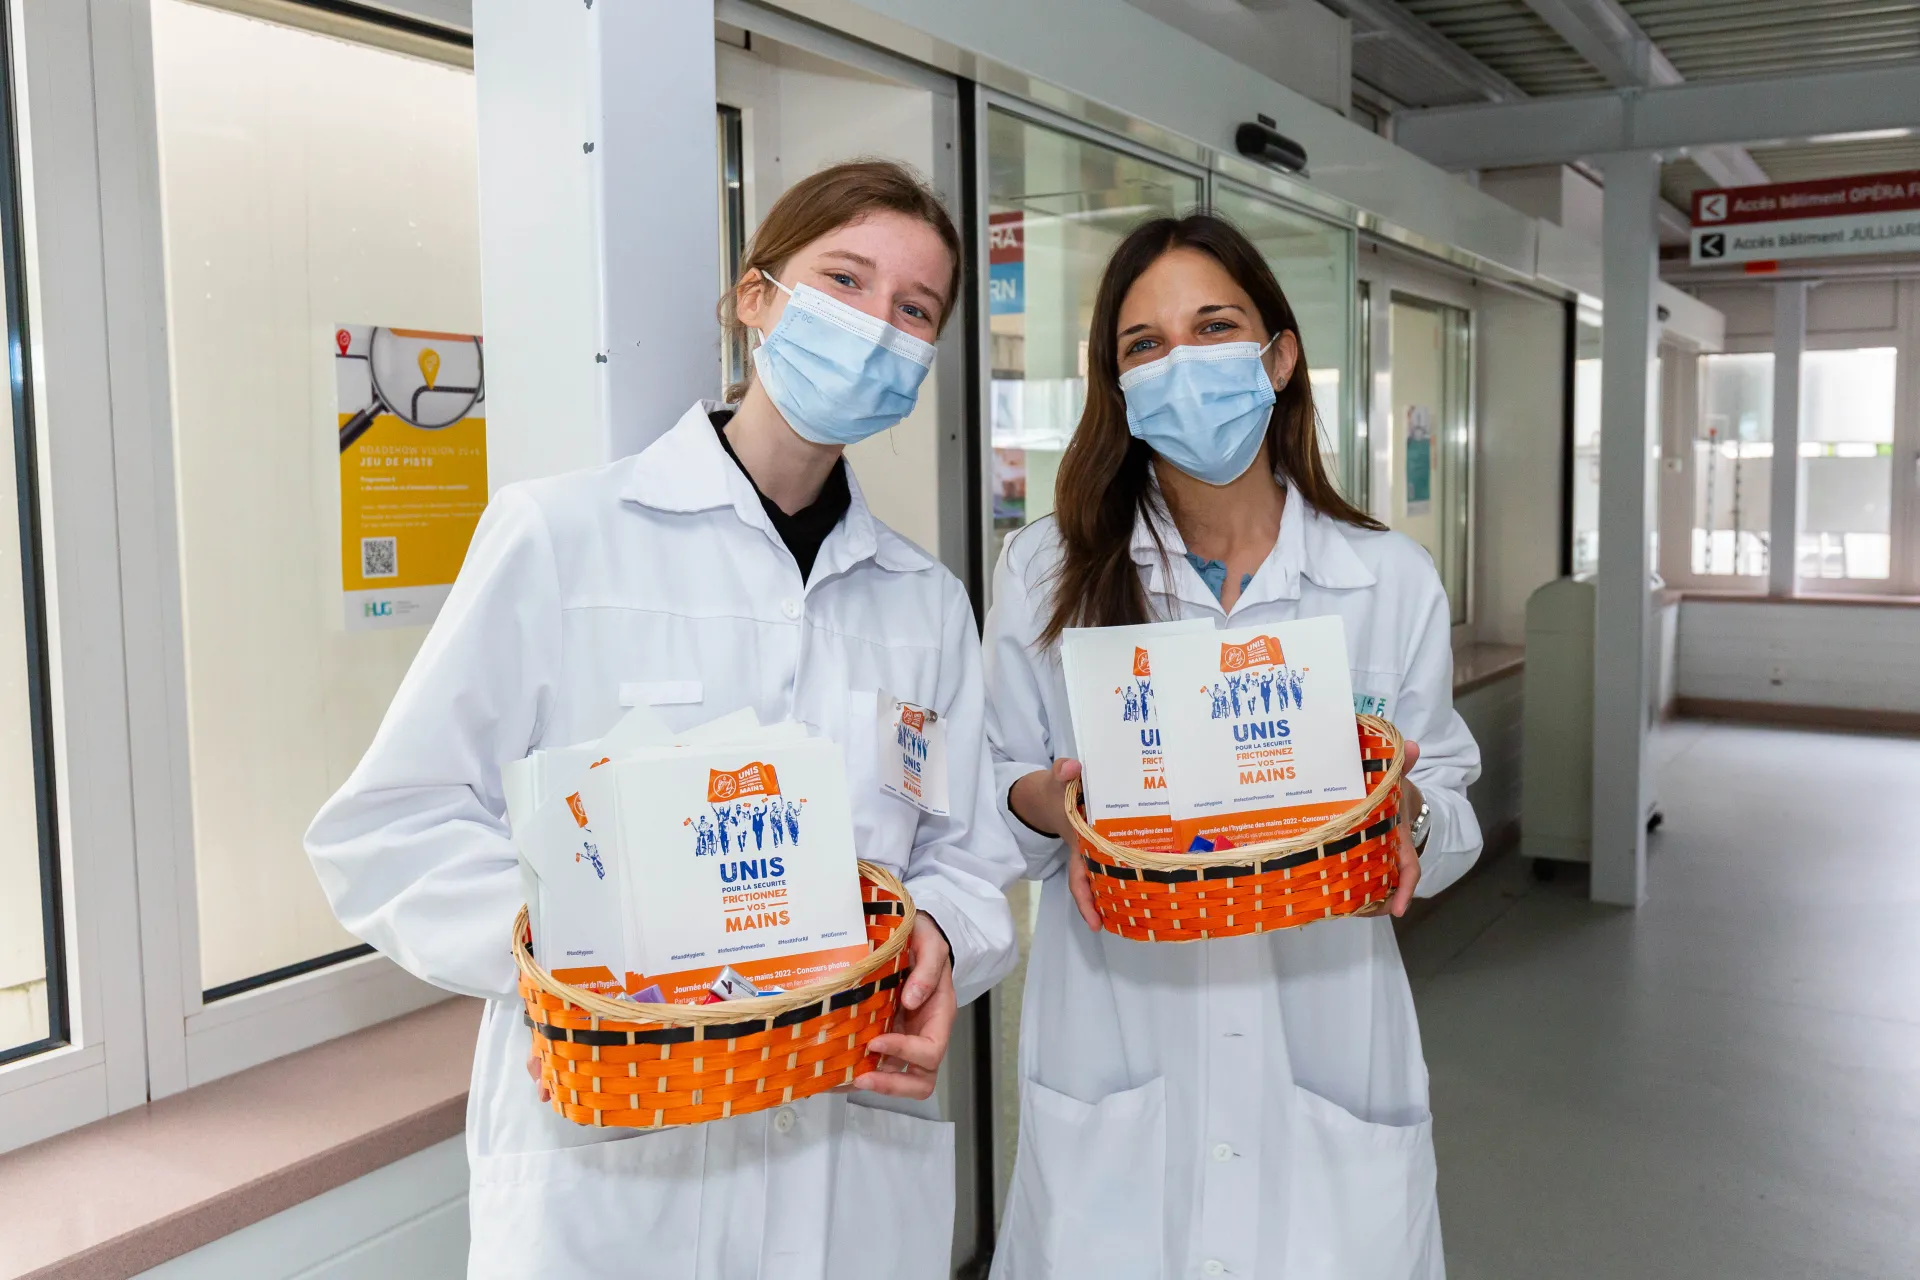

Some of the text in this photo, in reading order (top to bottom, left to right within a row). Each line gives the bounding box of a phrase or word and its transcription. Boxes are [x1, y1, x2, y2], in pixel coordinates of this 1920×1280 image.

[1734, 196, 1777, 213] Accès
[1780, 190, 1846, 209] bâtiment
[1850, 180, 1906, 203] OPÉRA
[1733, 236, 1775, 250] Accès
[1779, 229, 1845, 247] bâtiment
[360, 445, 419, 455] ROADSHOW
[421, 446, 455, 456] VISION
[360, 457, 434, 467] JEU DE PISTE
[1246, 639, 1266, 651] UNIS
[1248, 655, 1270, 664] MAINS
[1233, 719, 1290, 742] UNIS
[1263, 740, 1292, 748] SECURITE
[1236, 747, 1293, 760] FRICTIONNEZ
[903, 753, 921, 773] UNIS
[1258, 759, 1274, 767] VOS
[738, 765, 759, 779] UNIS
[1240, 766, 1296, 784] MAINS
[740, 784, 764, 793] MAINS
[903, 780, 921, 798] MAINS
[1144, 776, 1167, 789] MA
[1198, 826, 1220, 835] Journée
[1229, 823, 1254, 831] l'hygiène
[1302, 814, 1329, 823] Concours
[1108, 829, 1126, 837] Journée
[720, 857, 785, 883] UNIS
[754, 880, 786, 889] SECURITE
[722, 889, 787, 904] FRICTIONNEZ
[747, 903, 766, 911] VOS
[726, 910, 790, 933] MAINS
[674, 983, 701, 994] Journée
[702, 981, 710, 989] de
[755, 972, 774, 981] mains
[775, 969, 791, 978] 2022
[797, 965, 828, 974] Concours
[828, 961, 850, 972] photos
